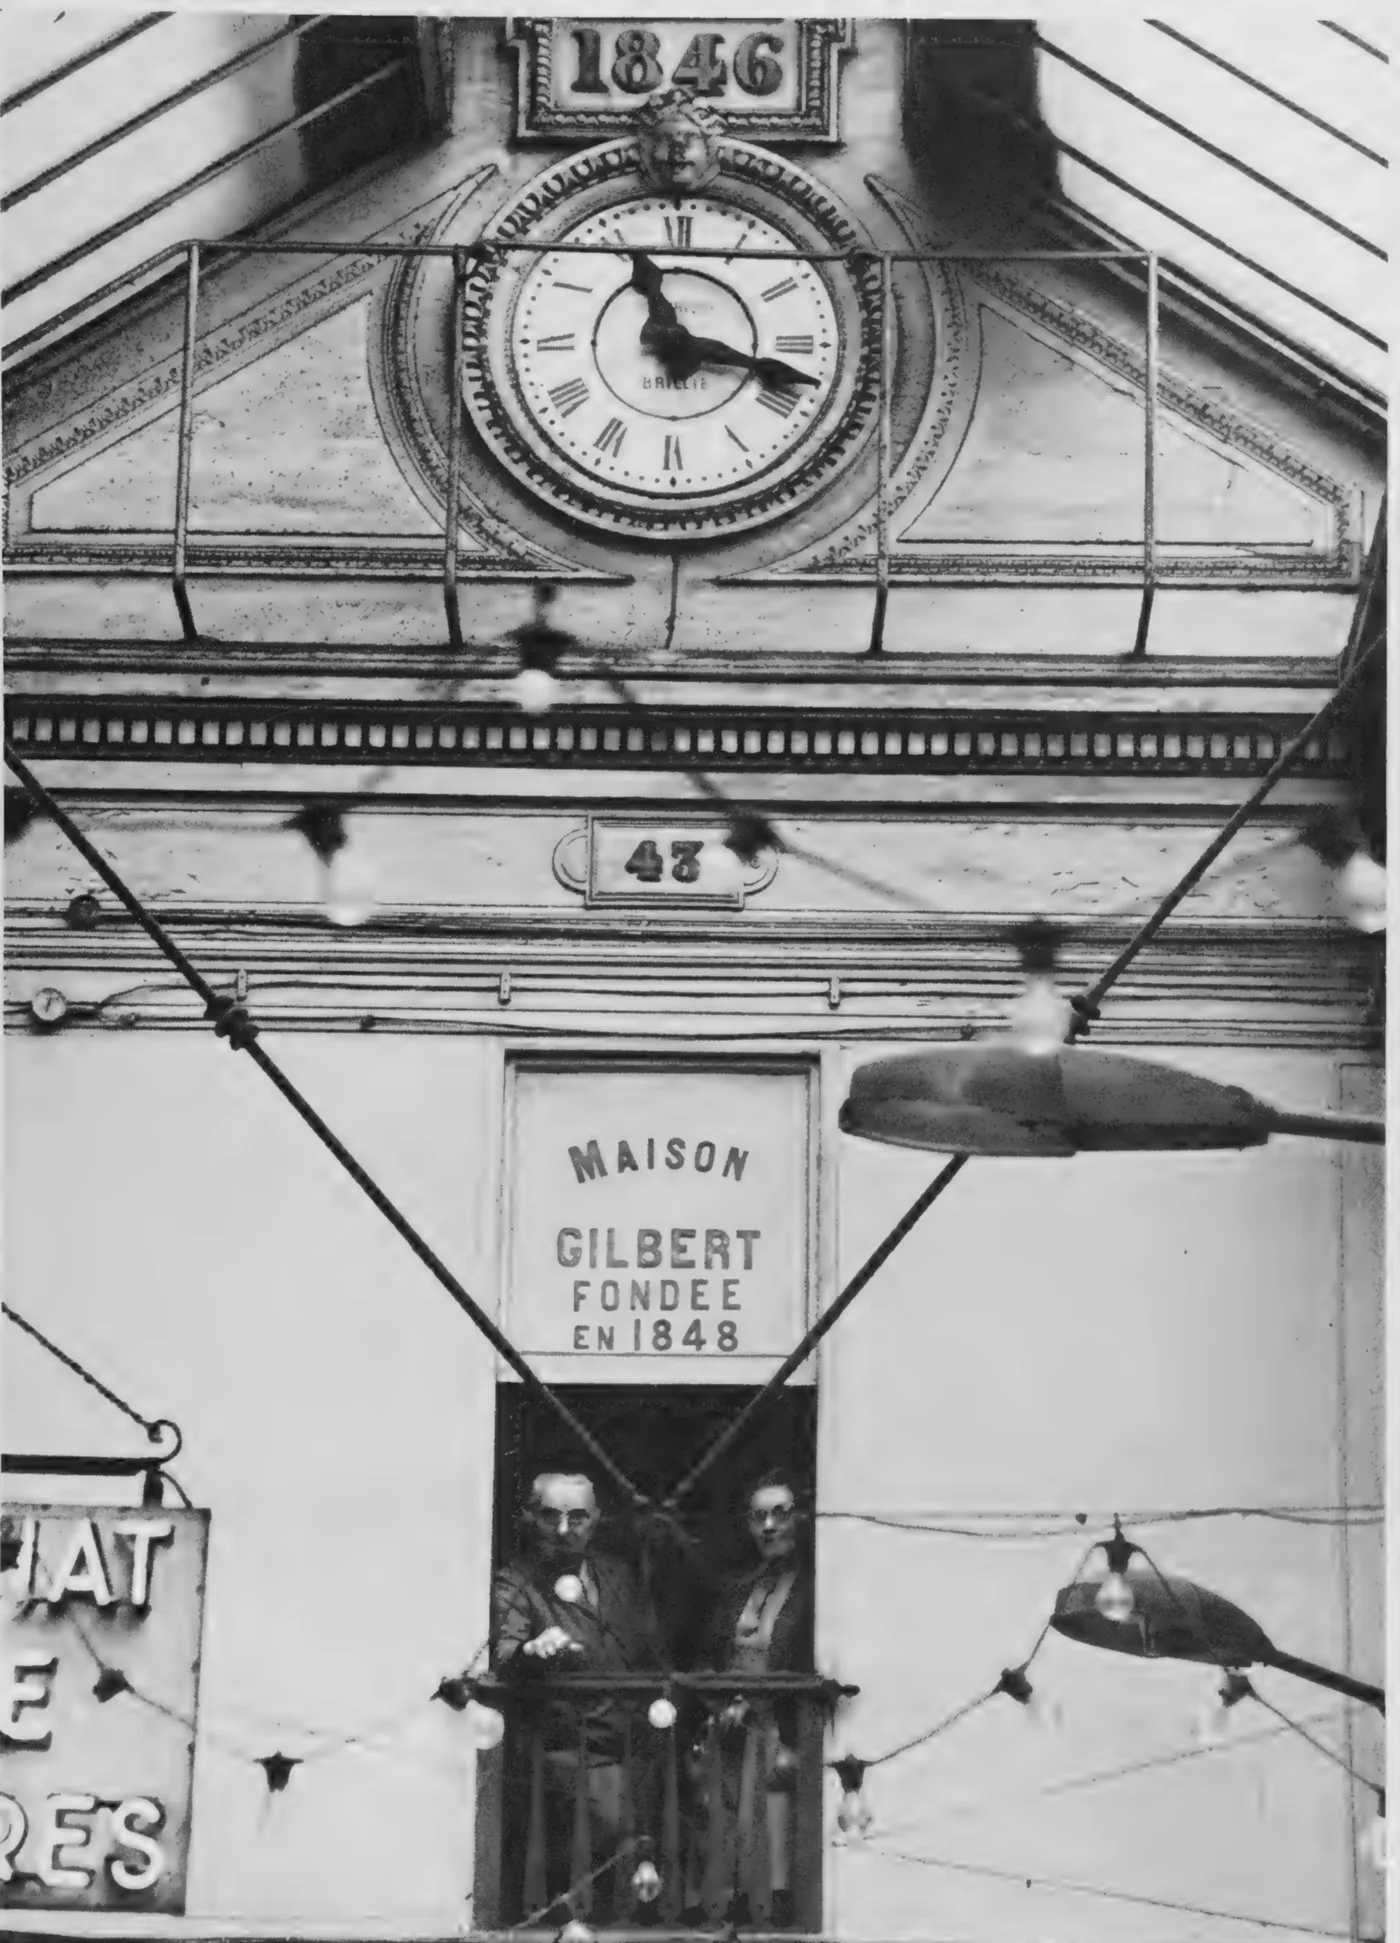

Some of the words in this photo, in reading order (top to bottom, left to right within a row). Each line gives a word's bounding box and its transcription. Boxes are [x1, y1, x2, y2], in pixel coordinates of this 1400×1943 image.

[569, 27, 786, 97] 1846
[775, 335, 814, 354] III
[624, 840, 705, 883] 43
[567, 1137, 750, 1184] MAISON
[556, 1227, 762, 1271] GILBERT
[572, 1278, 742, 1312] FONDEE
[573, 1324, 616, 1351] EN
[632, 1318, 739, 1352] 1848
